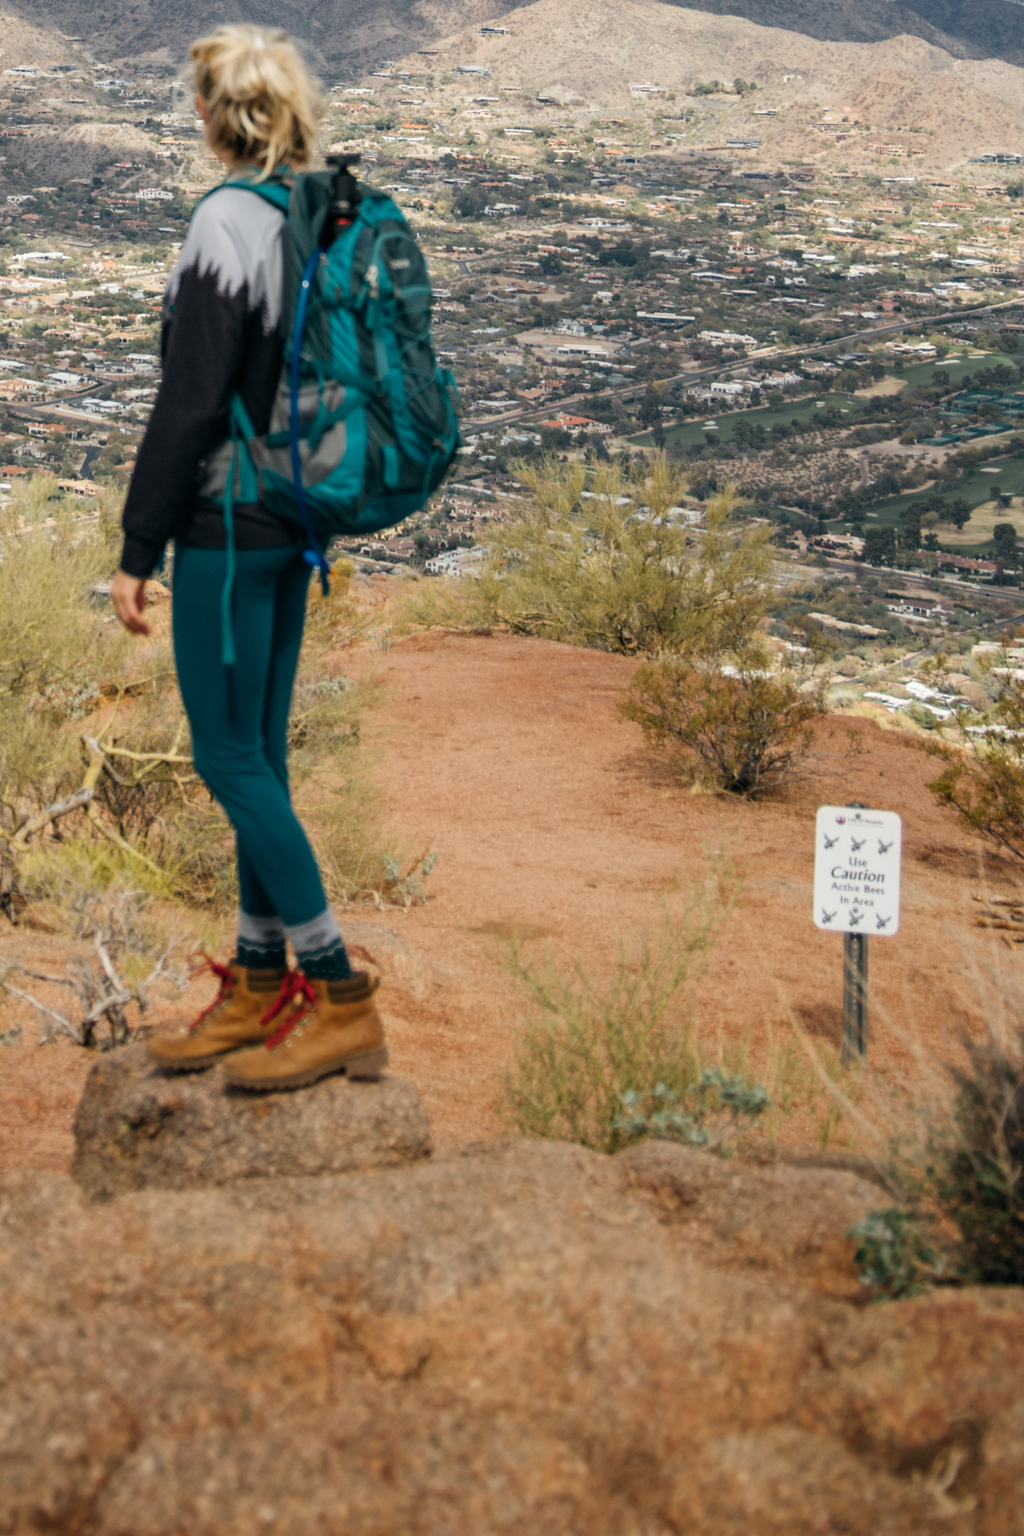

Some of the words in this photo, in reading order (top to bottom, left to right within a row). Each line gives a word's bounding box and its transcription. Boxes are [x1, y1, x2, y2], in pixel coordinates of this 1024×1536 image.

[849, 856, 868, 867] Use
[831, 866, 885, 883] Caution
[831, 882, 861, 893] Active
[864, 884, 885, 895] Bees
[840, 895, 849, 905] In
[852, 896, 874, 907] Area
